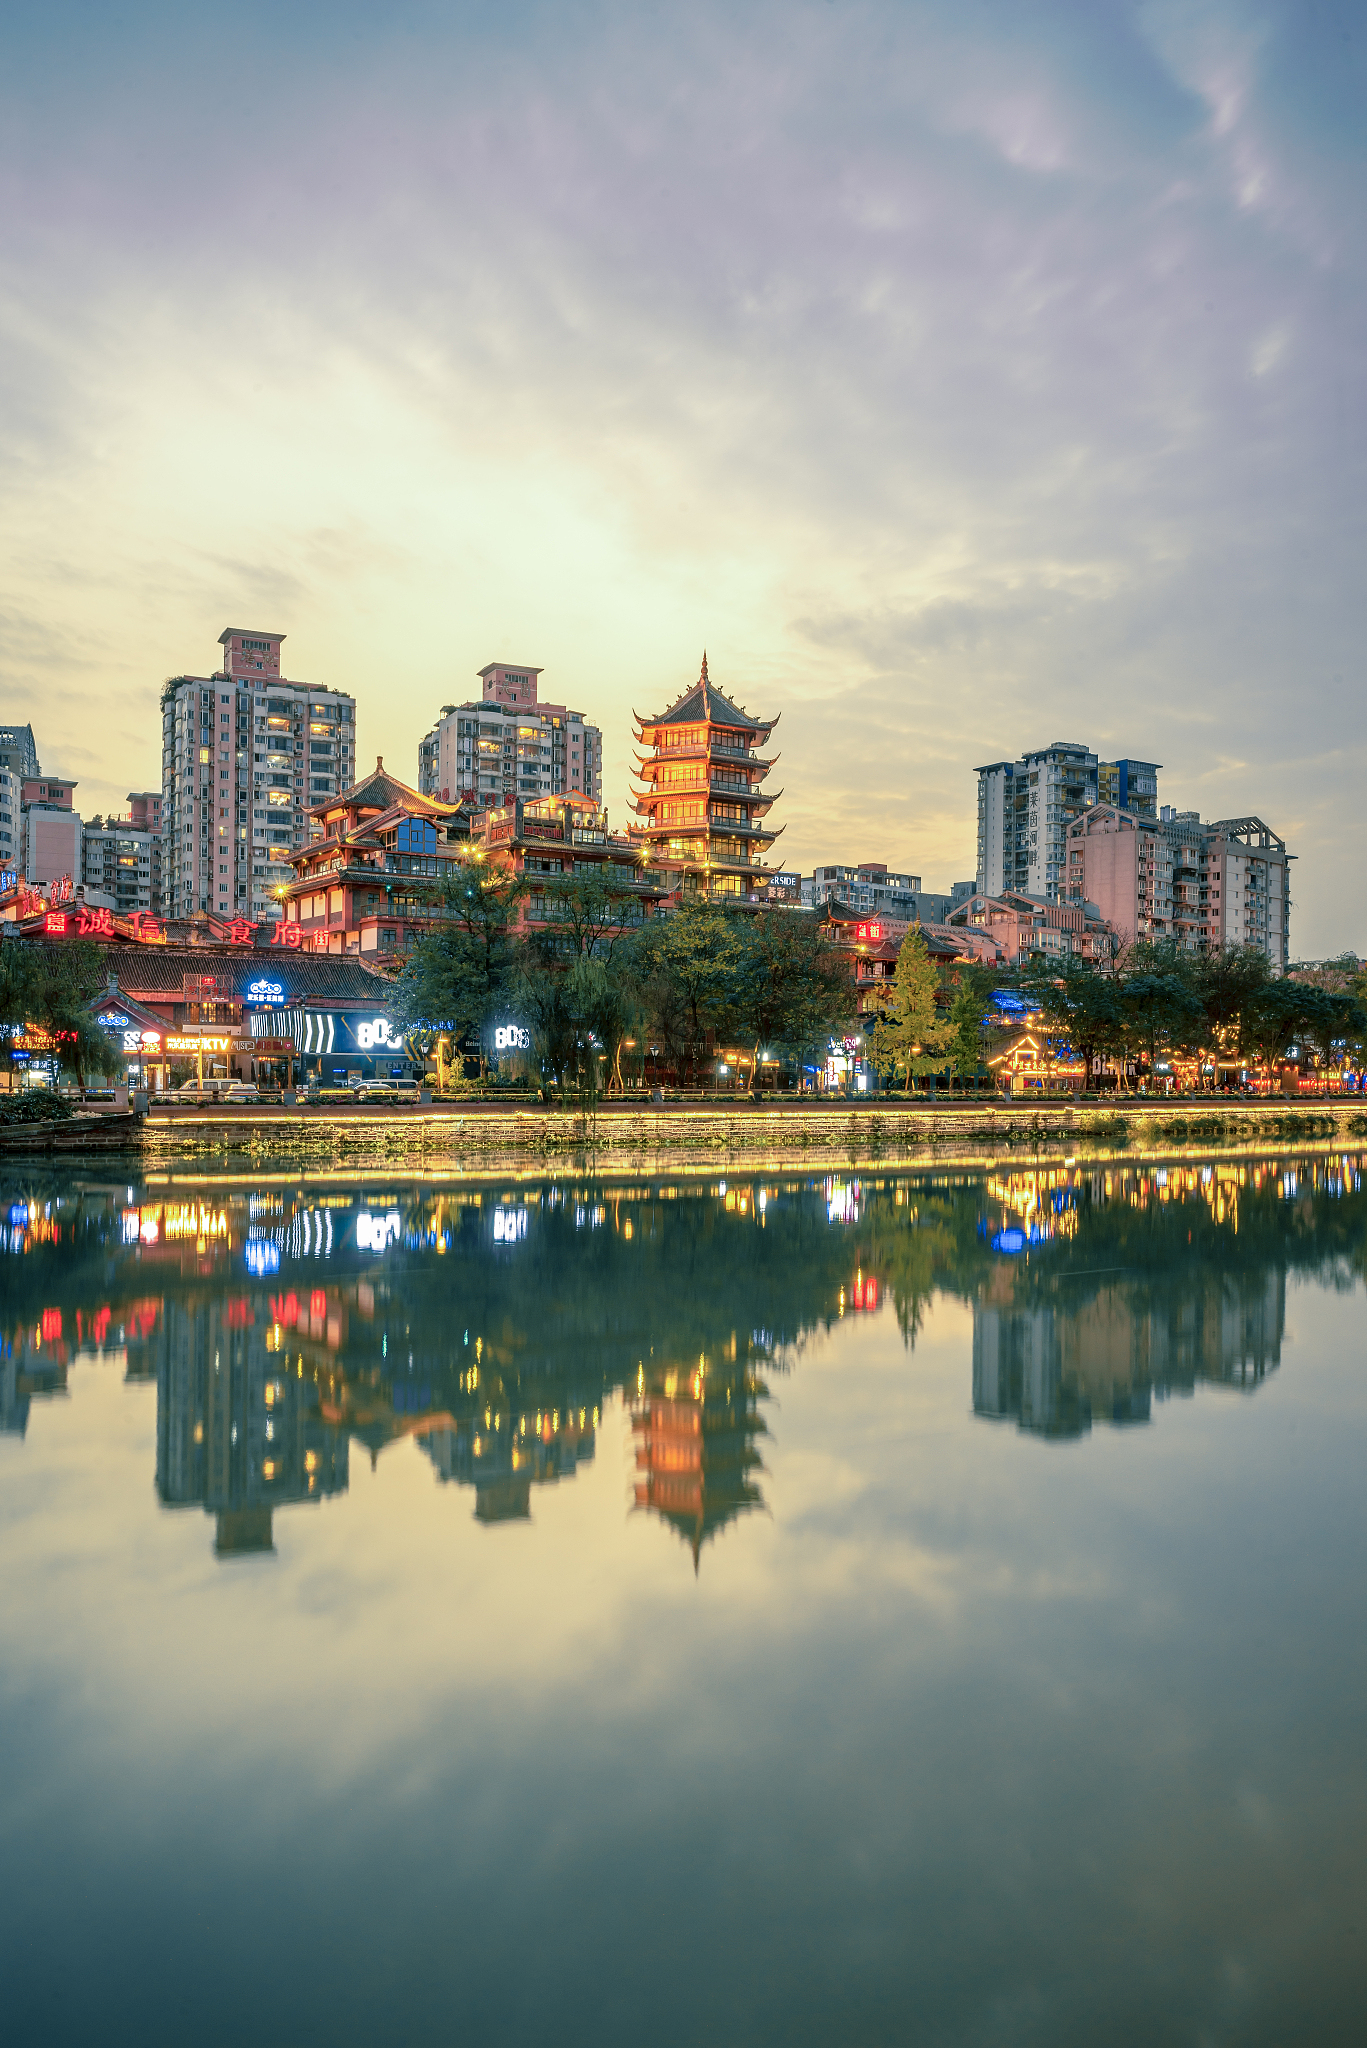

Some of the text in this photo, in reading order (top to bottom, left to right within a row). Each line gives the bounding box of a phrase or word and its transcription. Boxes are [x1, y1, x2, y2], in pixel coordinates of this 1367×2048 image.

[1029, 791, 1039, 867] 莱茵河畔
[203, 1038, 229, 1050] KTV
[495, 1025, 529, 1049] 808
[387, 1061, 418, 1070] ENTER
